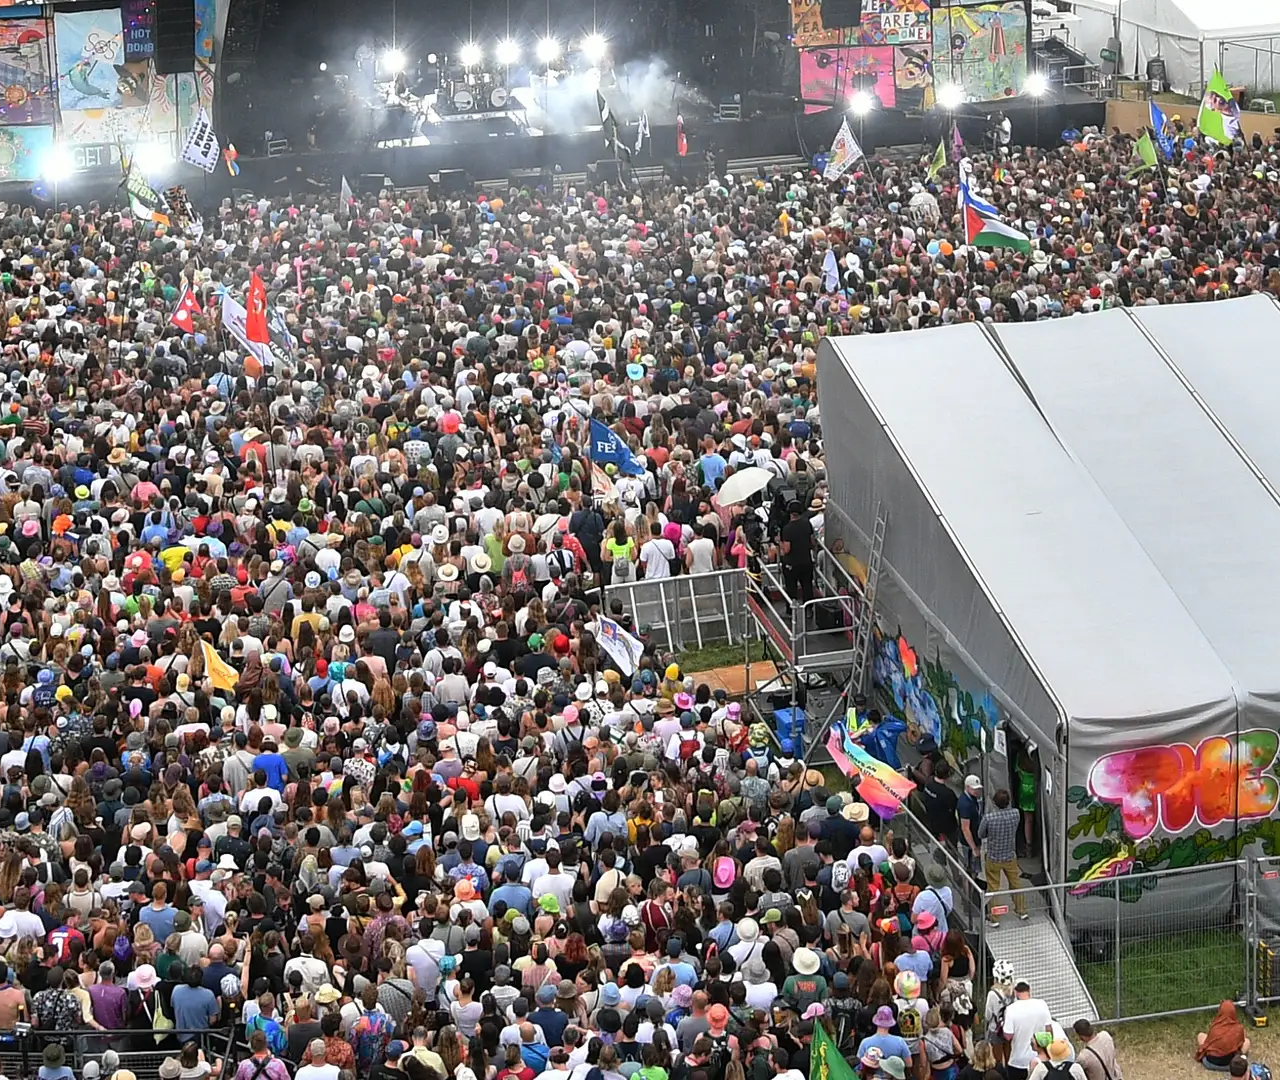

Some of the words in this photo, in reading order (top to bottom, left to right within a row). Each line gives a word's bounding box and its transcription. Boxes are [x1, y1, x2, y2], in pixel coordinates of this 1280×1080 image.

[883, 14, 911, 28] ARE
[900, 27, 924, 39] ONE
[131, 28, 151, 40] NOT
[84, 33, 119, 60] SOS
[194, 121, 209, 148] FREE
[200, 129, 215, 159] ADVI
[72, 146, 104, 167] GET
[1089, 728, 1280, 839] THE
